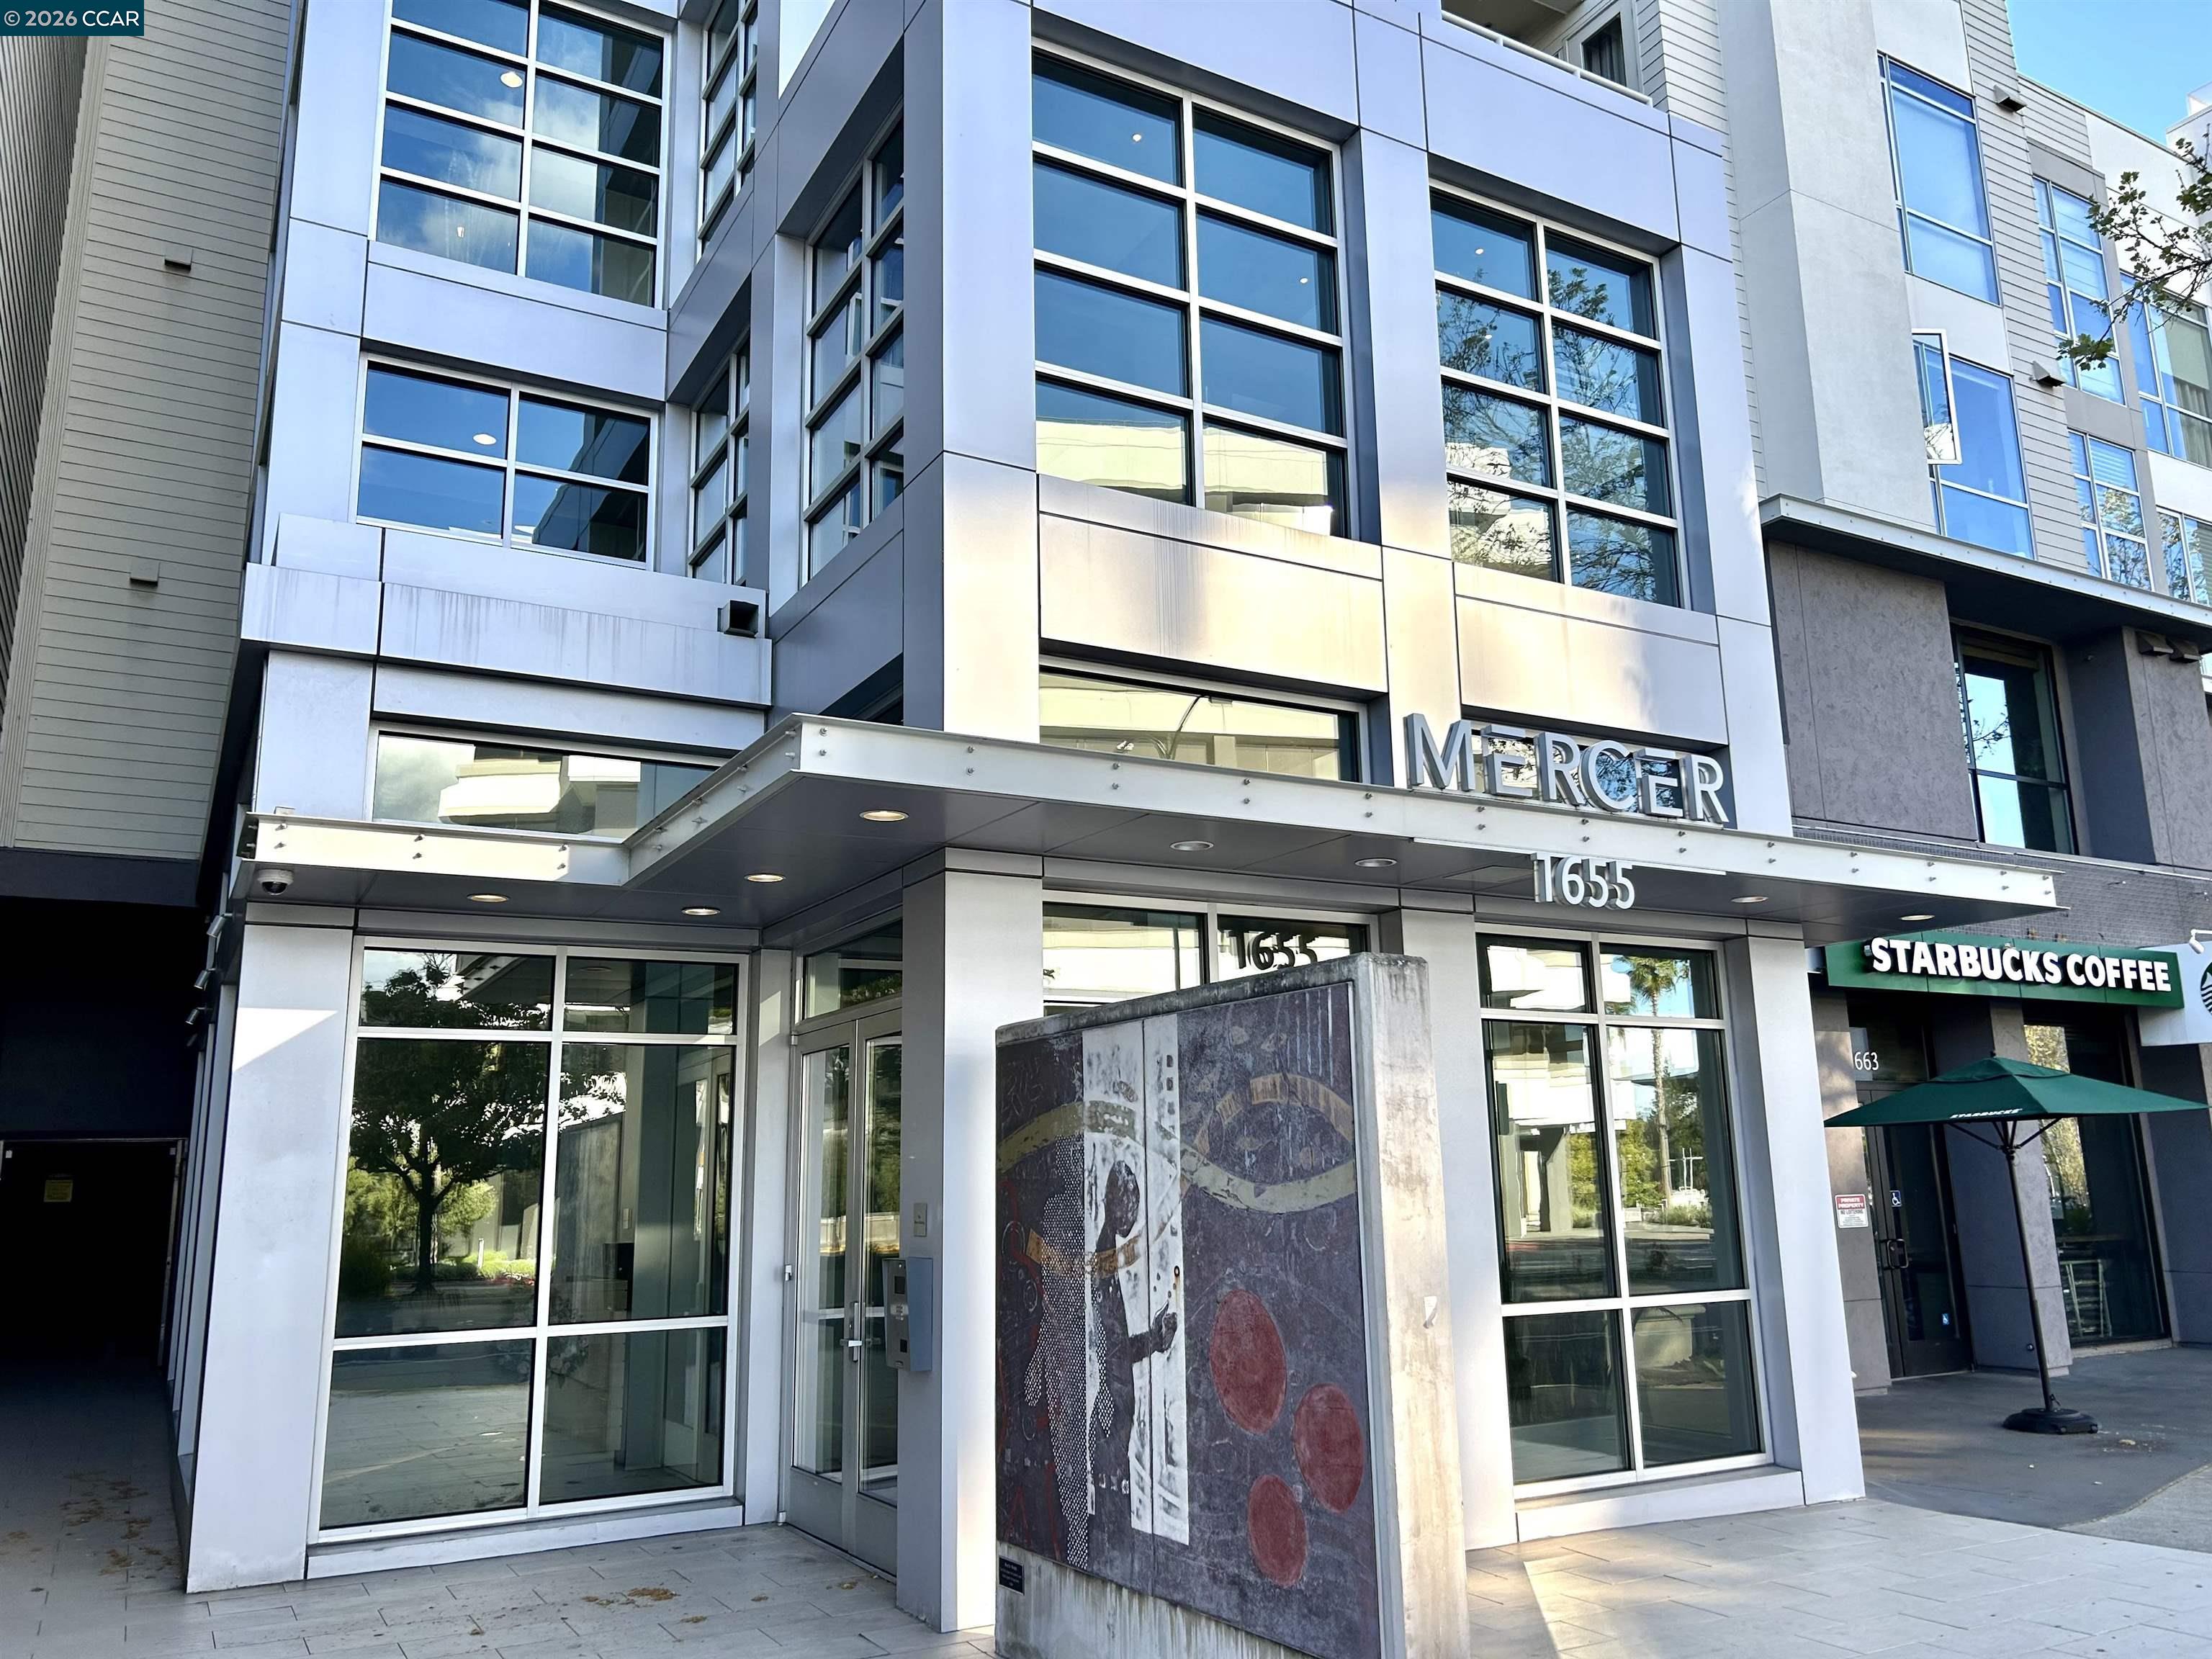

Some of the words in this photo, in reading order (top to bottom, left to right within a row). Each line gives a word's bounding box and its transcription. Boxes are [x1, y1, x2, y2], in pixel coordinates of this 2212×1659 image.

[1403, 713, 1730, 823] MERCER
[1531, 852, 1635, 910] 1655
[1870, 936, 2062, 984] STARBUCKS
[2066, 953, 2172, 992] COFFEE
